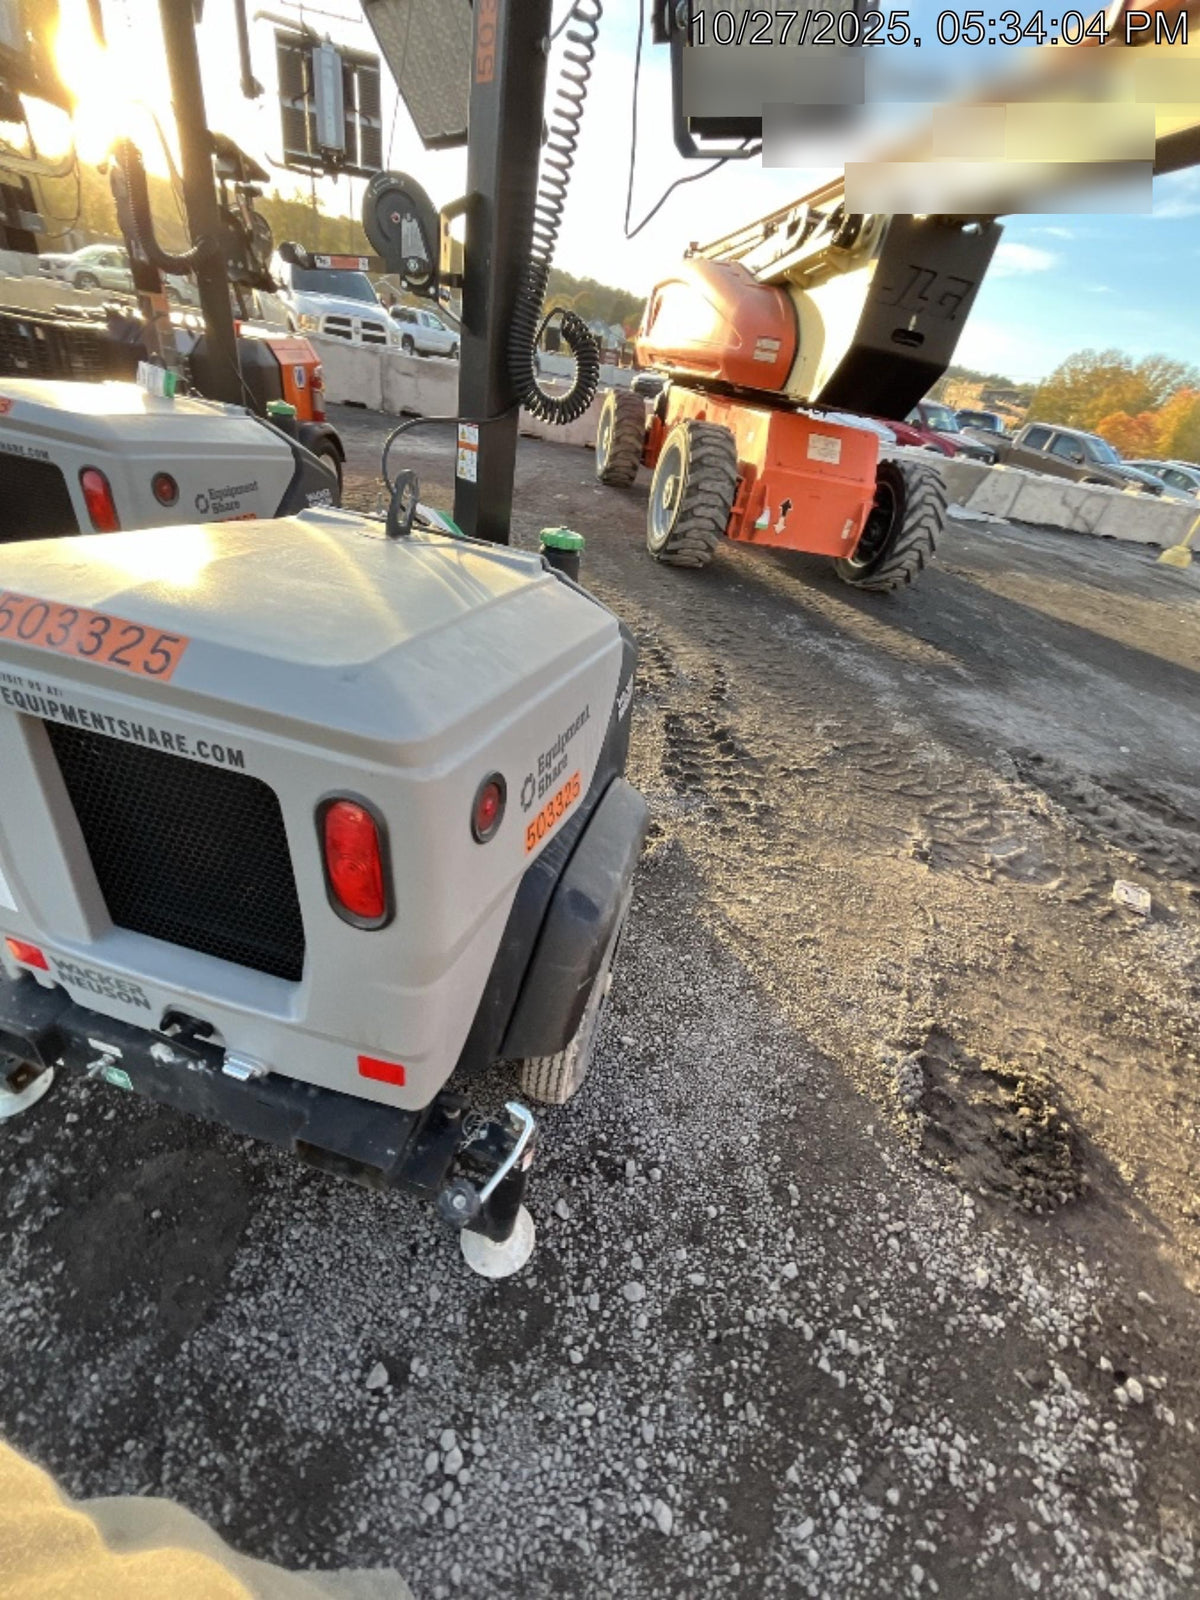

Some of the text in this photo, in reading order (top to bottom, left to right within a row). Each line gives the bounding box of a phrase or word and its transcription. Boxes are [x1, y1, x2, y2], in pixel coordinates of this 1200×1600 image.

[0, 595, 180, 674] 503325
[1, 686, 245, 768] EQUIPMENTSHARE.COM
[537, 704, 590, 776] Equipment
[527, 773, 580, 850] 503325
[538, 754, 568, 798] Share
[51, 956, 147, 996] WACKER
[58, 970, 151, 1010] NEUSON
